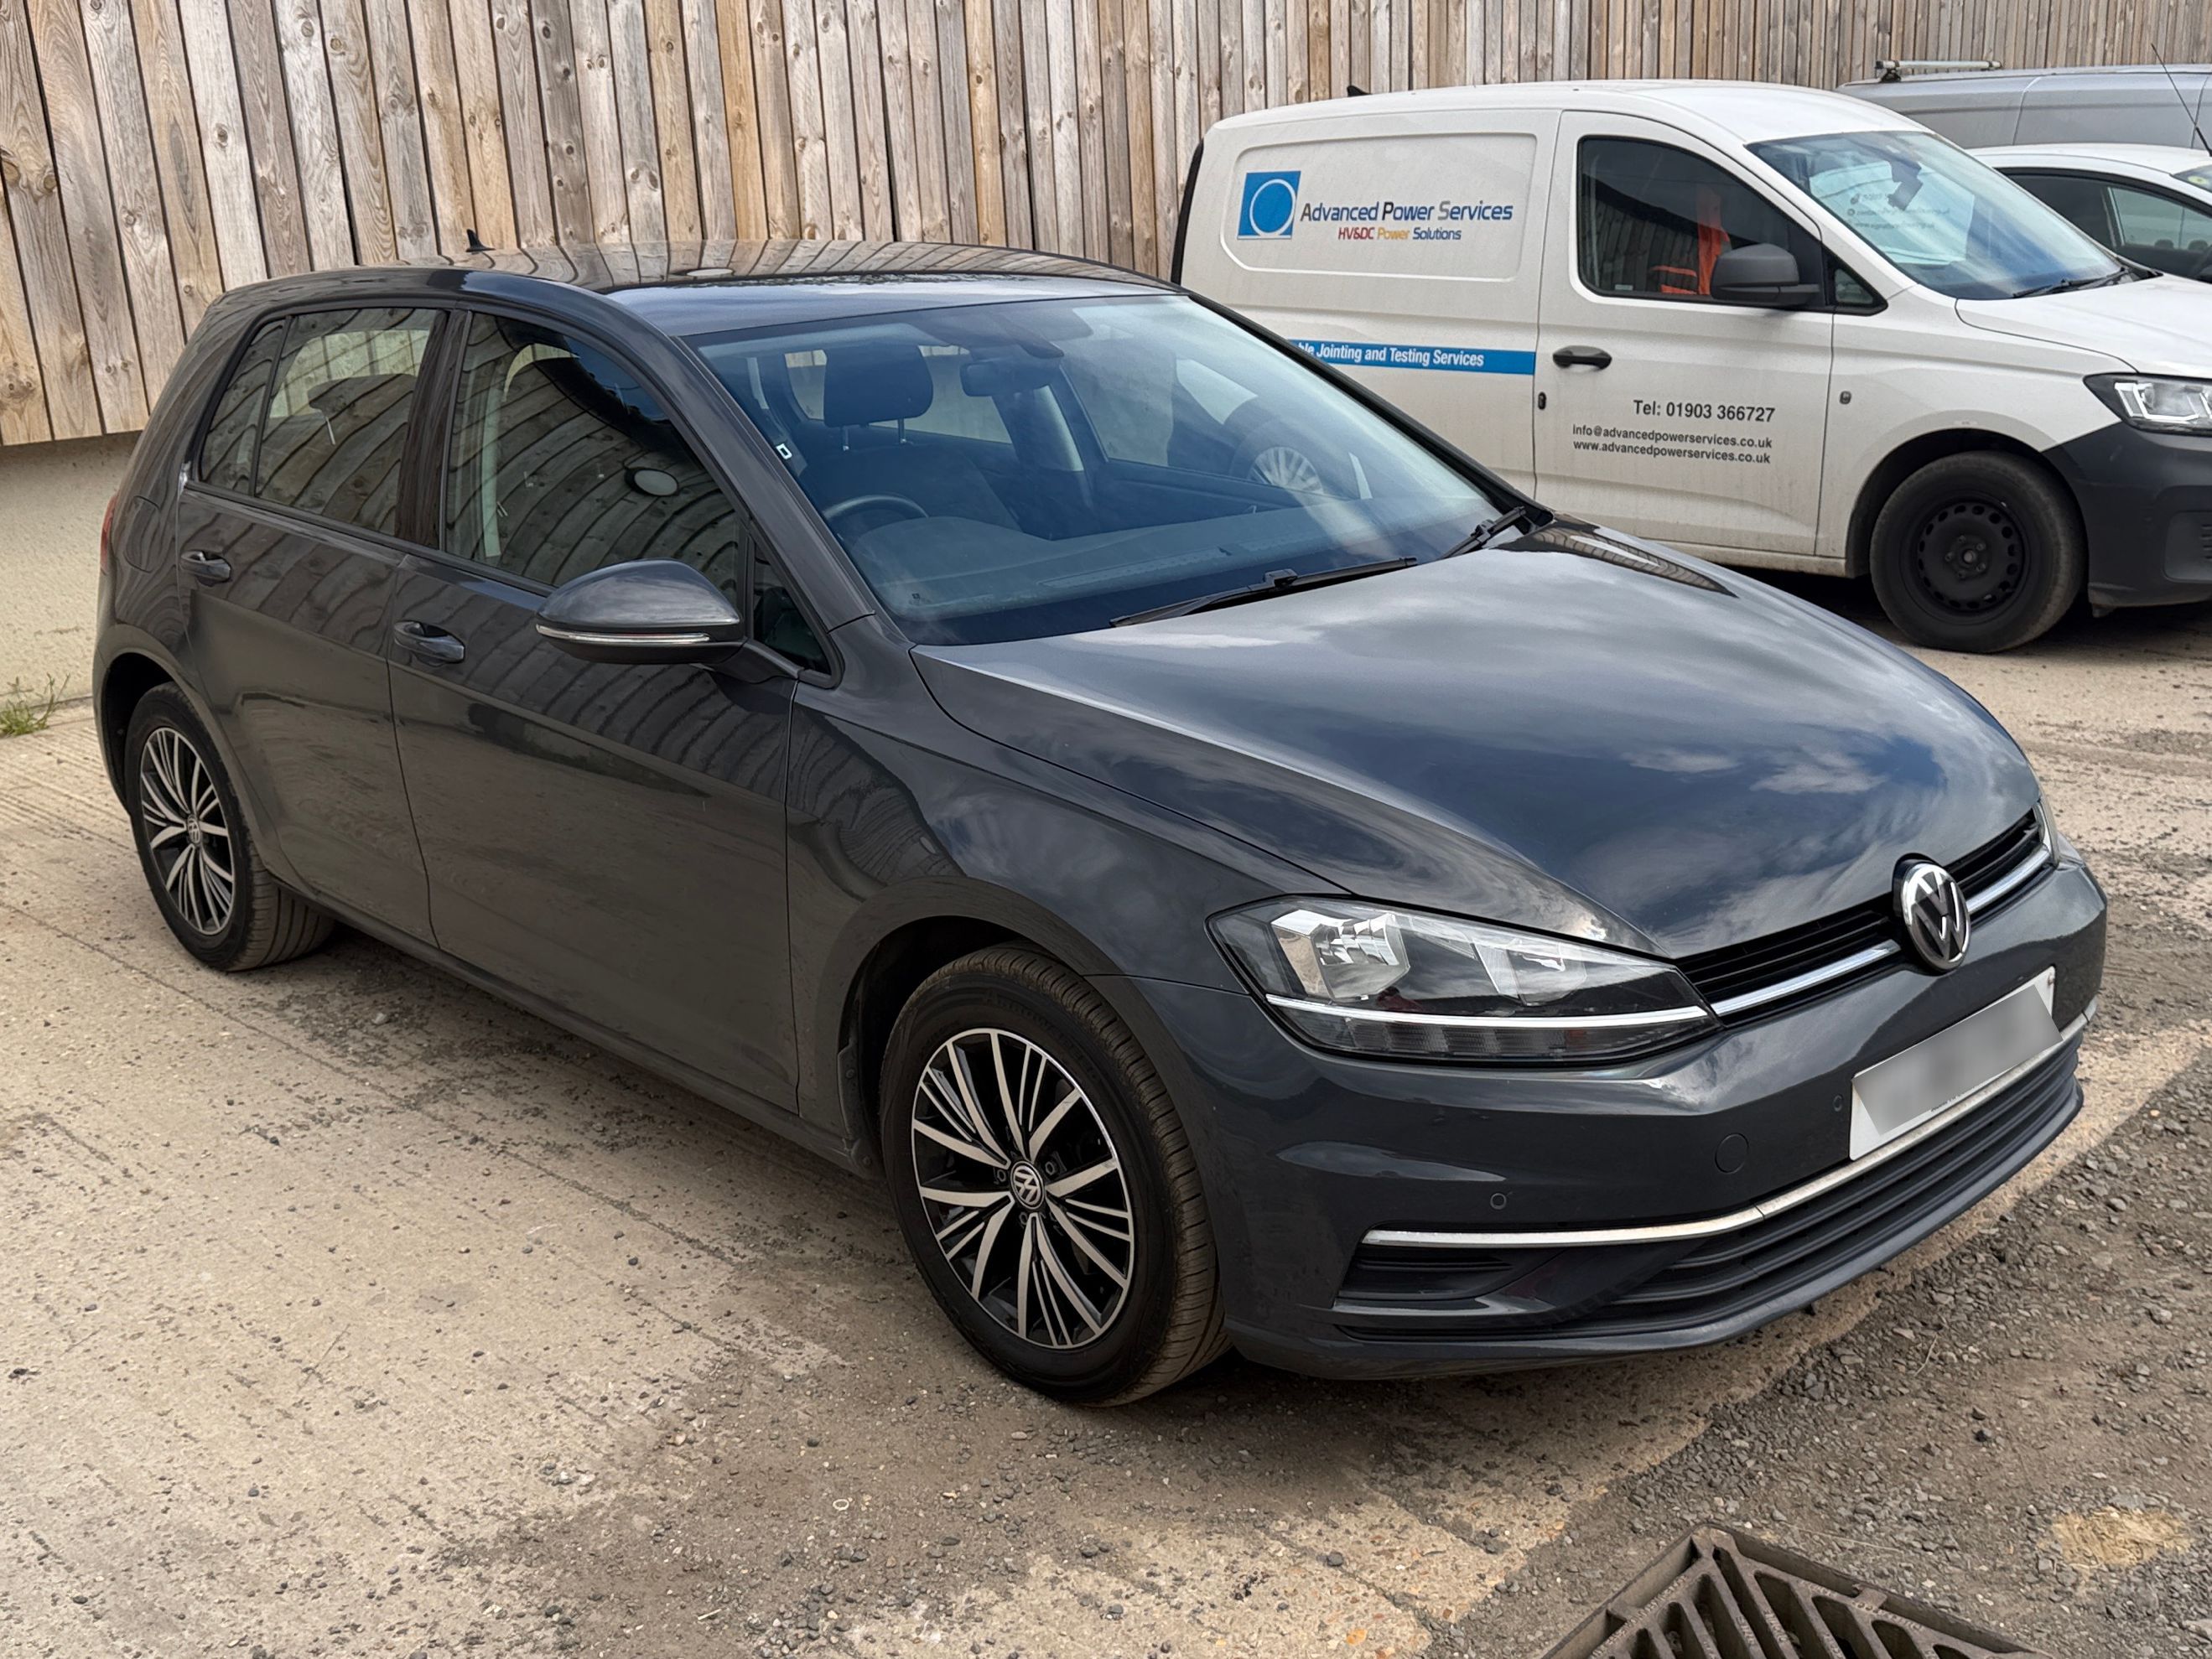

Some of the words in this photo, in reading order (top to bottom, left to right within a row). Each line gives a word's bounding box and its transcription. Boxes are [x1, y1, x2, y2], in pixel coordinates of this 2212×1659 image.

[1301, 201, 1380, 222] Advanced
[1382, 201, 1435, 221] Power
[1437, 200, 1514, 221] Services
[1337, 227, 1375, 241] HV&DC
[1377, 226, 1410, 240] Power
[1412, 226, 1462, 241] Solutions
[1316, 343, 1363, 363] Jointing
[1364, 346, 1386, 362] and
[1389, 346, 1431, 366] Testing
[1432, 349, 1484, 367] Services
[1633, 399, 1661, 417] Tel:
[1665, 402, 1713, 419] 01903
[1716, 404, 1776, 423] 366727
[1573, 439, 1771, 464] www.advancedpowerservices.co.uk
